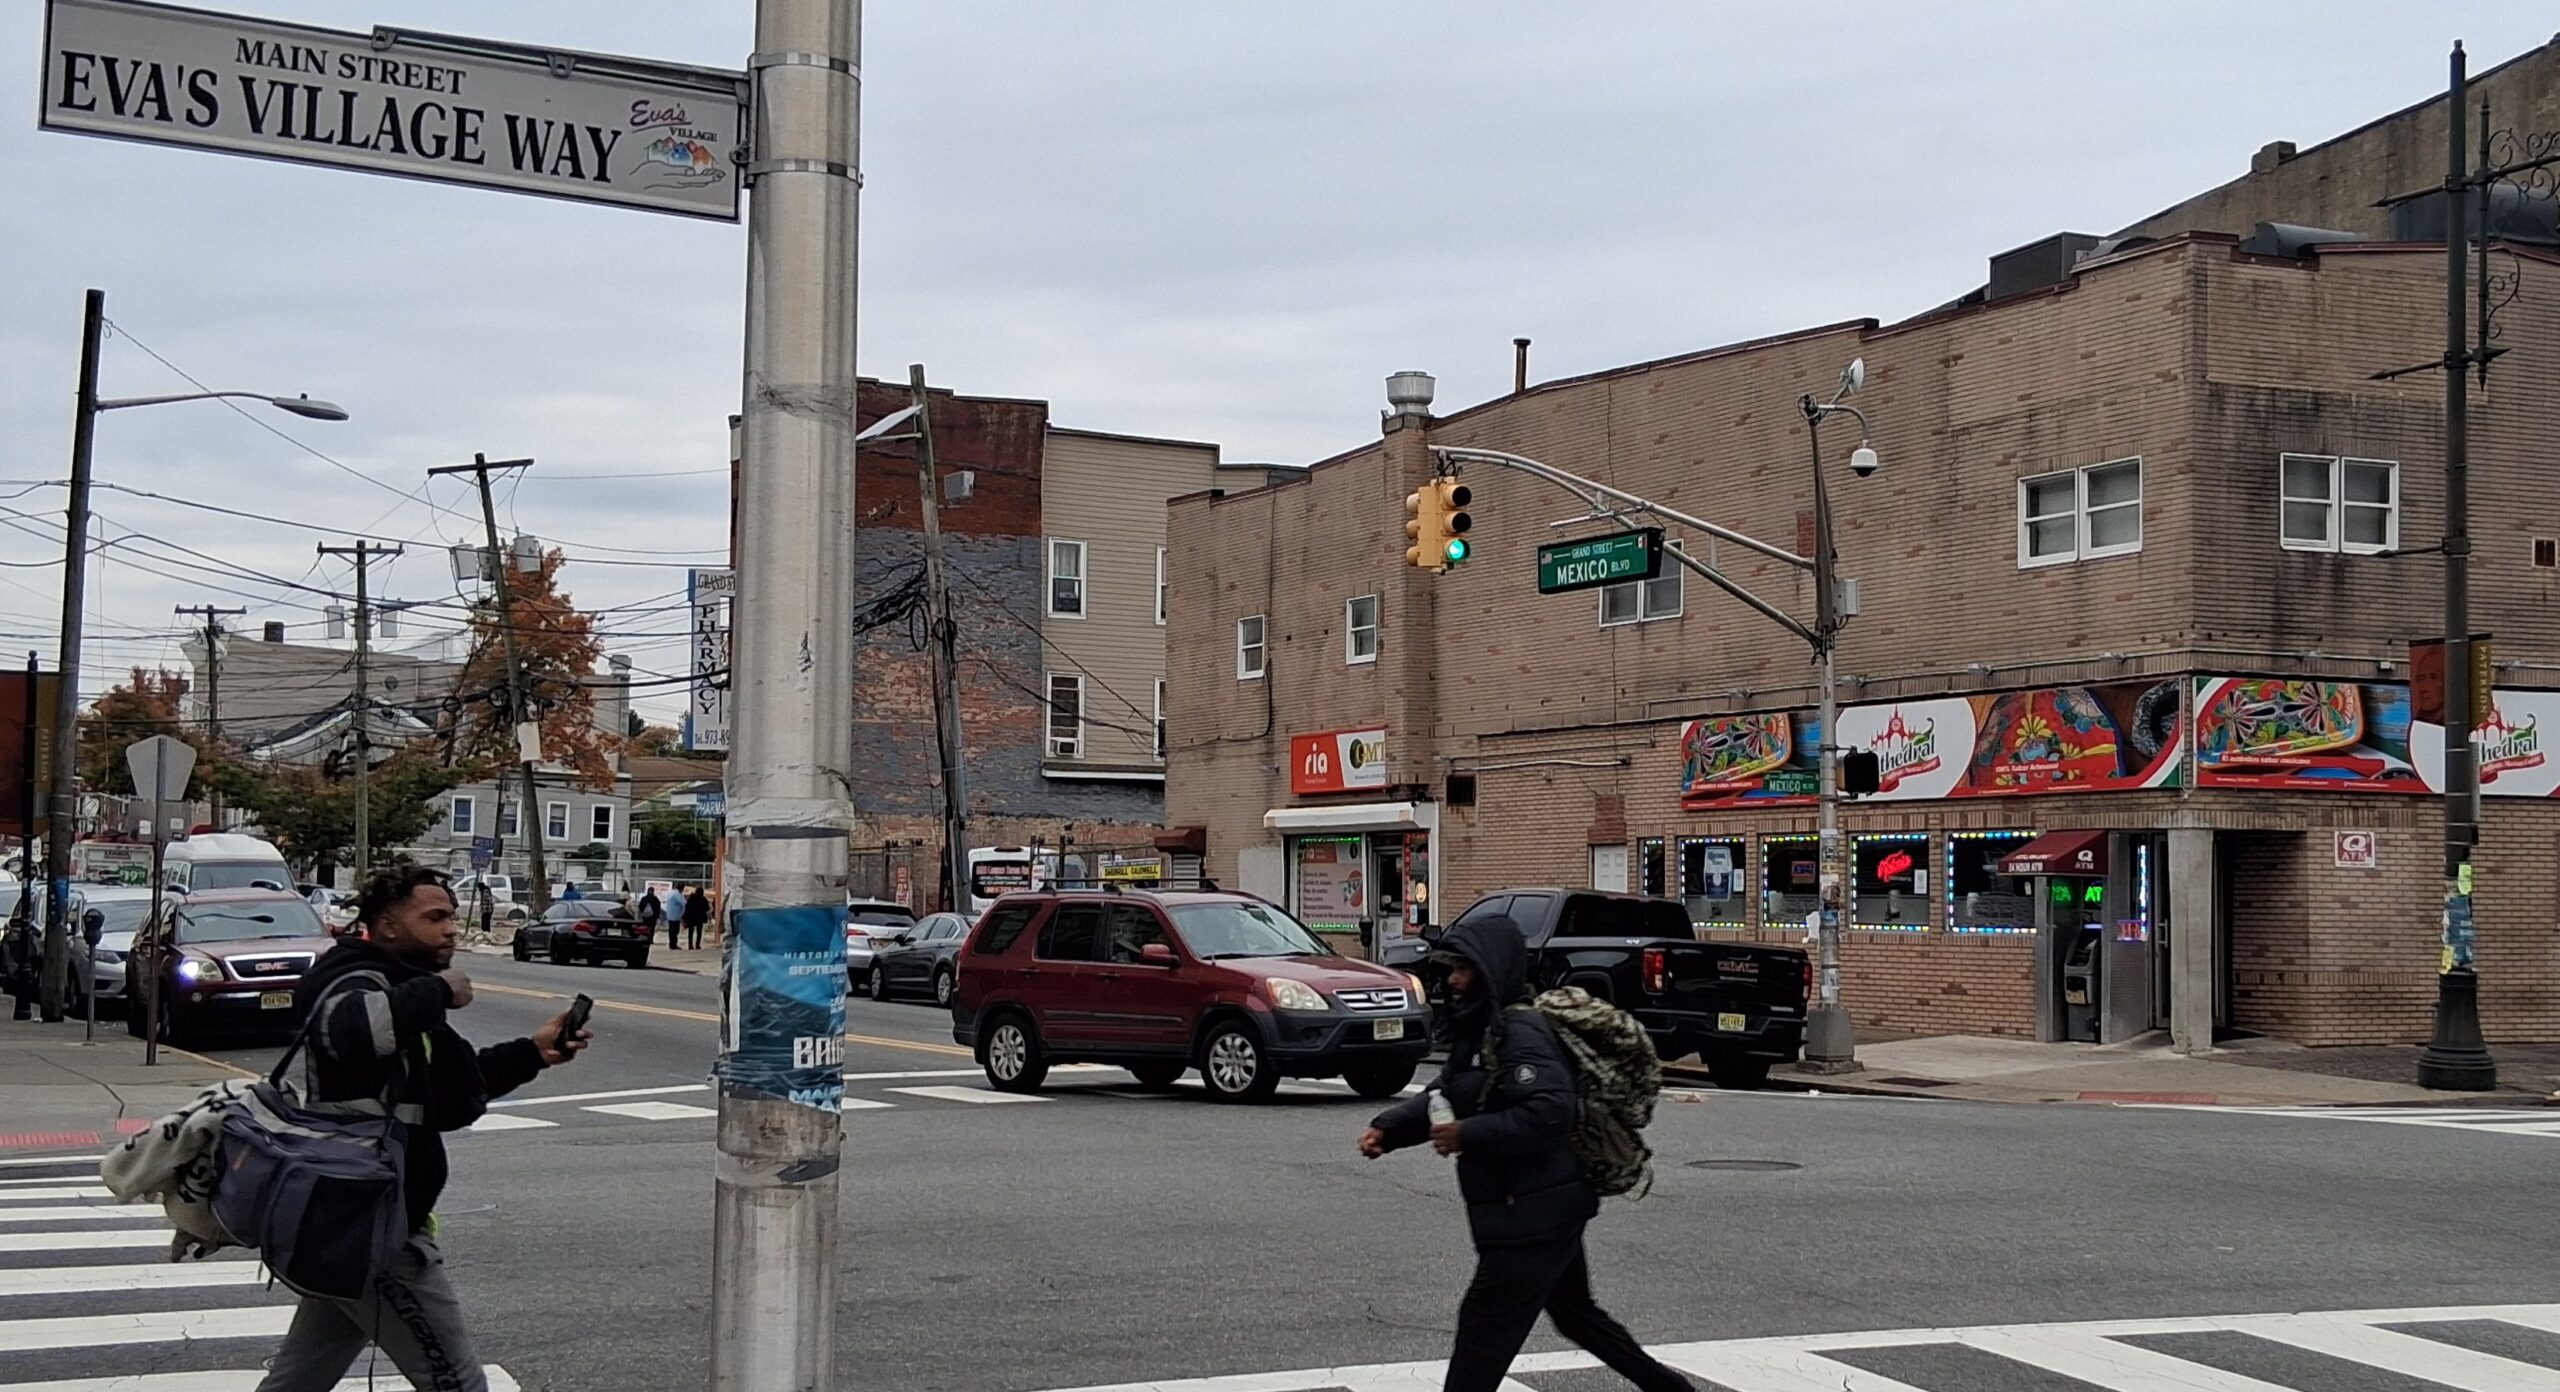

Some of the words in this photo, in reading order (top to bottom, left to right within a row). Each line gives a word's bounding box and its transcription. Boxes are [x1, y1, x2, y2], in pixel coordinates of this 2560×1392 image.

[235, 37, 329, 74] MAIN
[337, 52, 467, 96] STREET
[59, 50, 219, 128] EVA'S
[238, 76, 487, 166] VILLAGE
[504, 113, 622, 183] WAY
[629, 99, 687, 127] Eva's
[669, 126, 718, 143] VILLAGE
[1592, 541, 1614, 554] STREET
[1557, 558, 1608, 585] MEXICO
[1611, 559, 1630, 572] BLVD
[697, 606, 716, 716] PHARMACY
[2479, 645, 2488, 714] PATERSON
[704, 729, 730, 746] 973-89
[1304, 742, 1328, 775] ria
[1769, 780, 1801, 792] MEXICO
[2342, 835, 2367, 852] Q
[2077, 849, 2094, 862] Q
[2341, 851, 2369, 861] ATM
[2075, 862, 2094, 870] ATM
[255, 961, 290, 972] GMC
[1717, 960, 1760, 974] GMC
